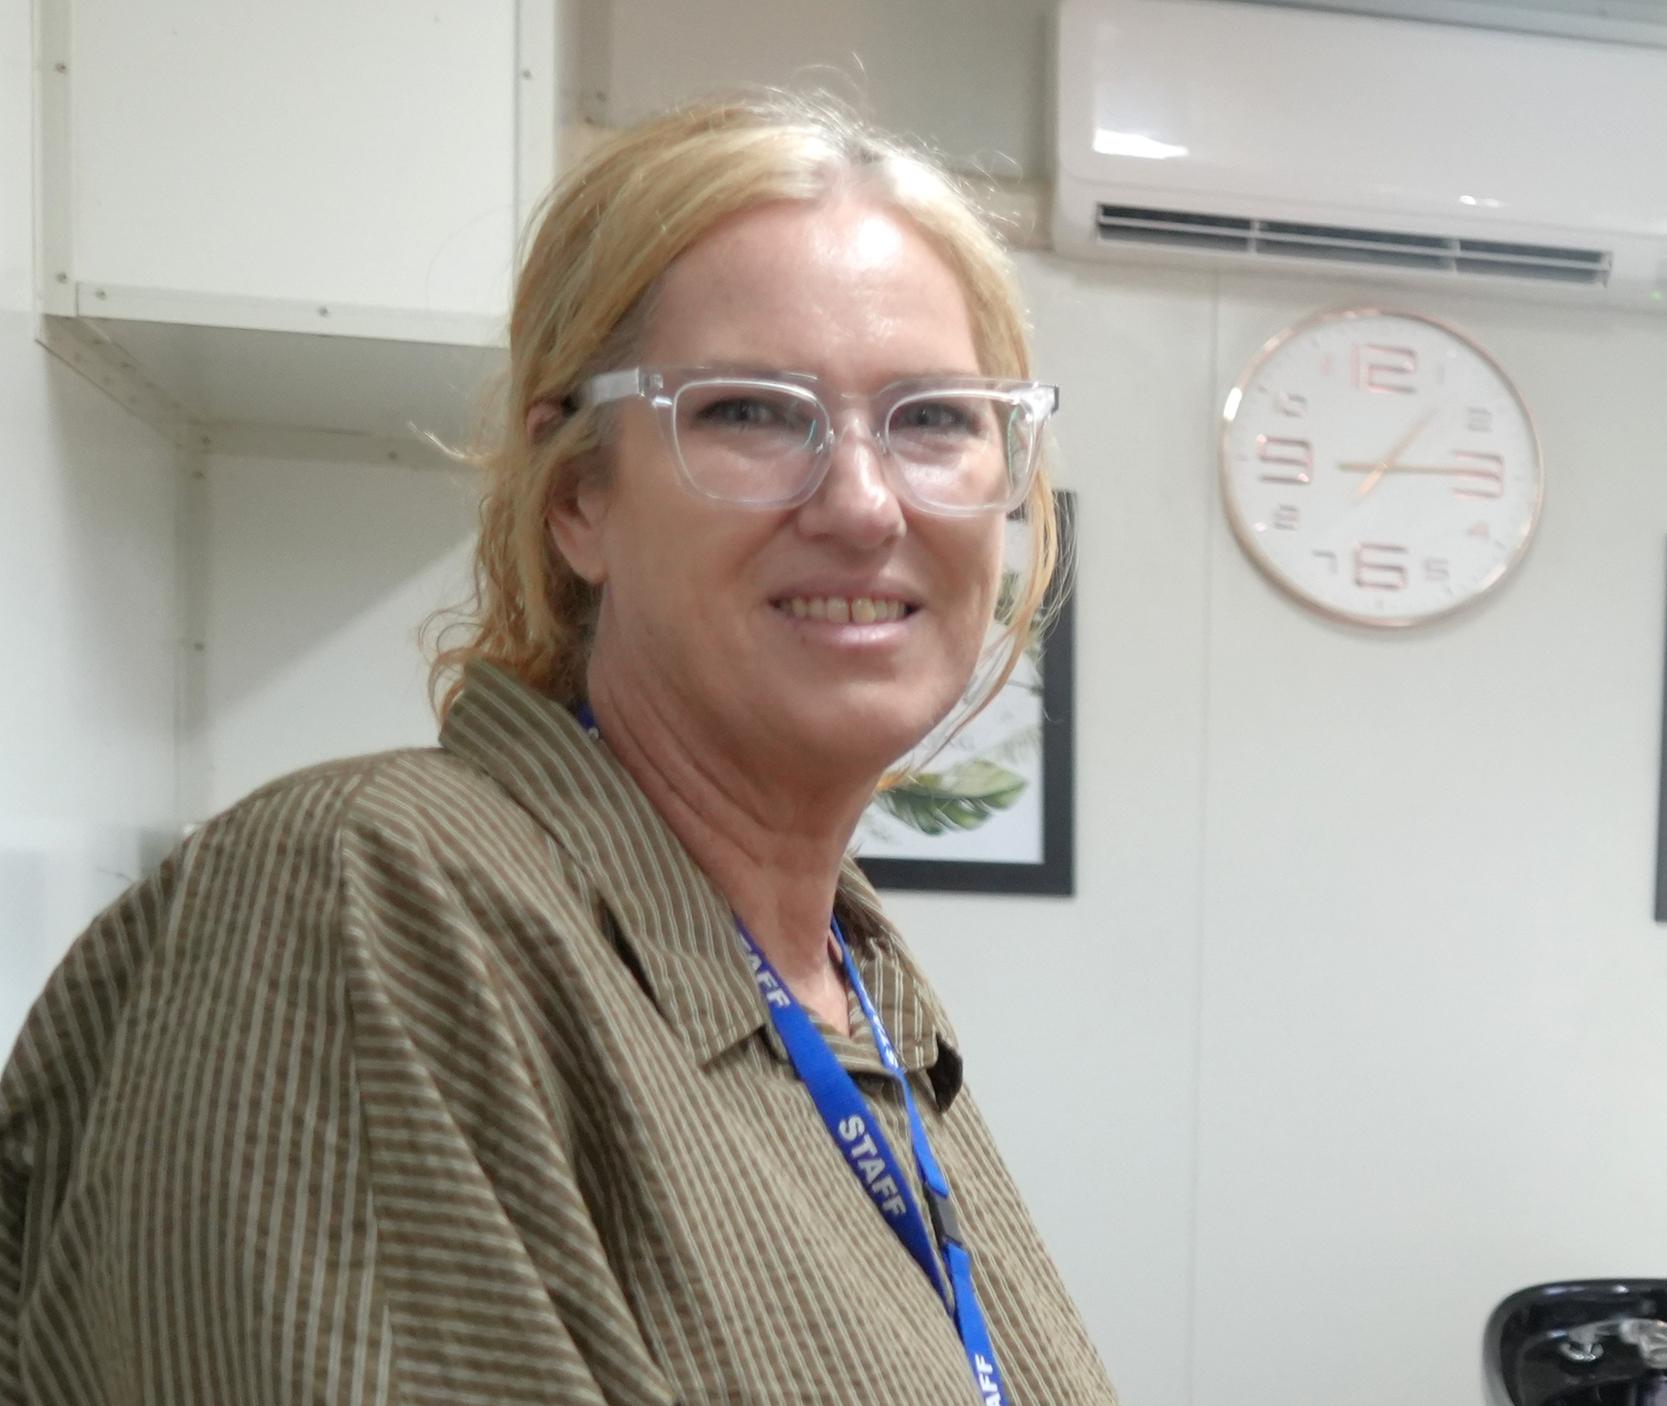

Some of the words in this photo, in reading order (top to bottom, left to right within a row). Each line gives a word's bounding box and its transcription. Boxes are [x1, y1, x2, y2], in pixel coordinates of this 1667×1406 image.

[1353, 343, 1417, 394] 12
[1258, 434, 1313, 485] 9
[1452, 449, 1505, 499] 3
[1352, 541, 1409, 592] 6
[838, 1114, 907, 1217] STAFF
